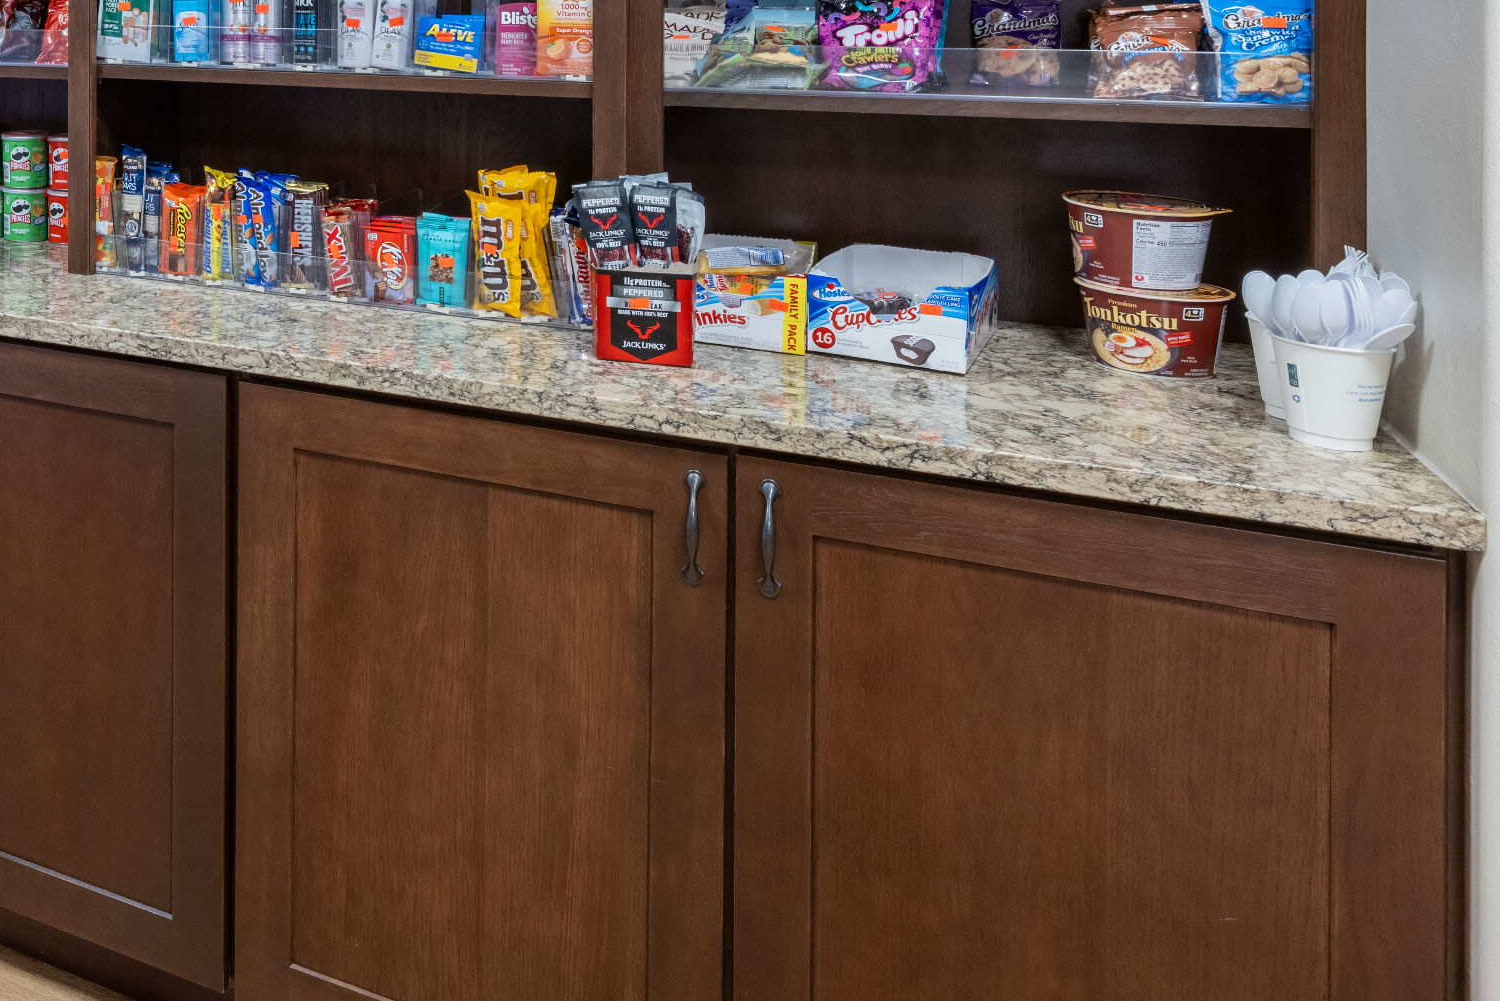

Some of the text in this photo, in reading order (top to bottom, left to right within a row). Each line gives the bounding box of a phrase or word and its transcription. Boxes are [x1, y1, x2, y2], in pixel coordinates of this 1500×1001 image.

[560, 3, 580, 11] 1000
[556, 10, 586, 18] Vitamin
[340, 26, 362, 34] OLAY
[380, 26, 402, 35] OLAY
[972, 12, 1059, 39] Grandma's
[841, 53, 898, 68] Crawlers
[10, 160, 31, 172] PRINGLES
[583, 198, 620, 207] PEPPERED
[634, 194, 669, 204] PEPPERED
[596, 206, 618, 214] PROTEIN
[644, 206, 666, 214] PROTEIN
[11, 214, 31, 224] PRINGLES
[294, 198, 314, 266] HERSHEY'S
[506, 220, 514, 240] PEANUT
[589, 230, 604, 238] JACK
[1156, 240, 1168, 248] 450
[575, 250, 589, 284] Ruth
[634, 278, 662, 287] PROTEIN
[623, 289, 664, 298] PEPPERED
[1108, 298, 1138, 308] Premium
[695, 310, 746, 326] inkies
[788, 284, 798, 352] FAMILY PACK
[830, 305, 918, 330] CupCes
[1083, 297, 1179, 330] Tonkotsu
[1111, 322, 1138, 333] Ramen
[816, 332, 833, 344] 16
[622, 341, 641, 350] JACK
